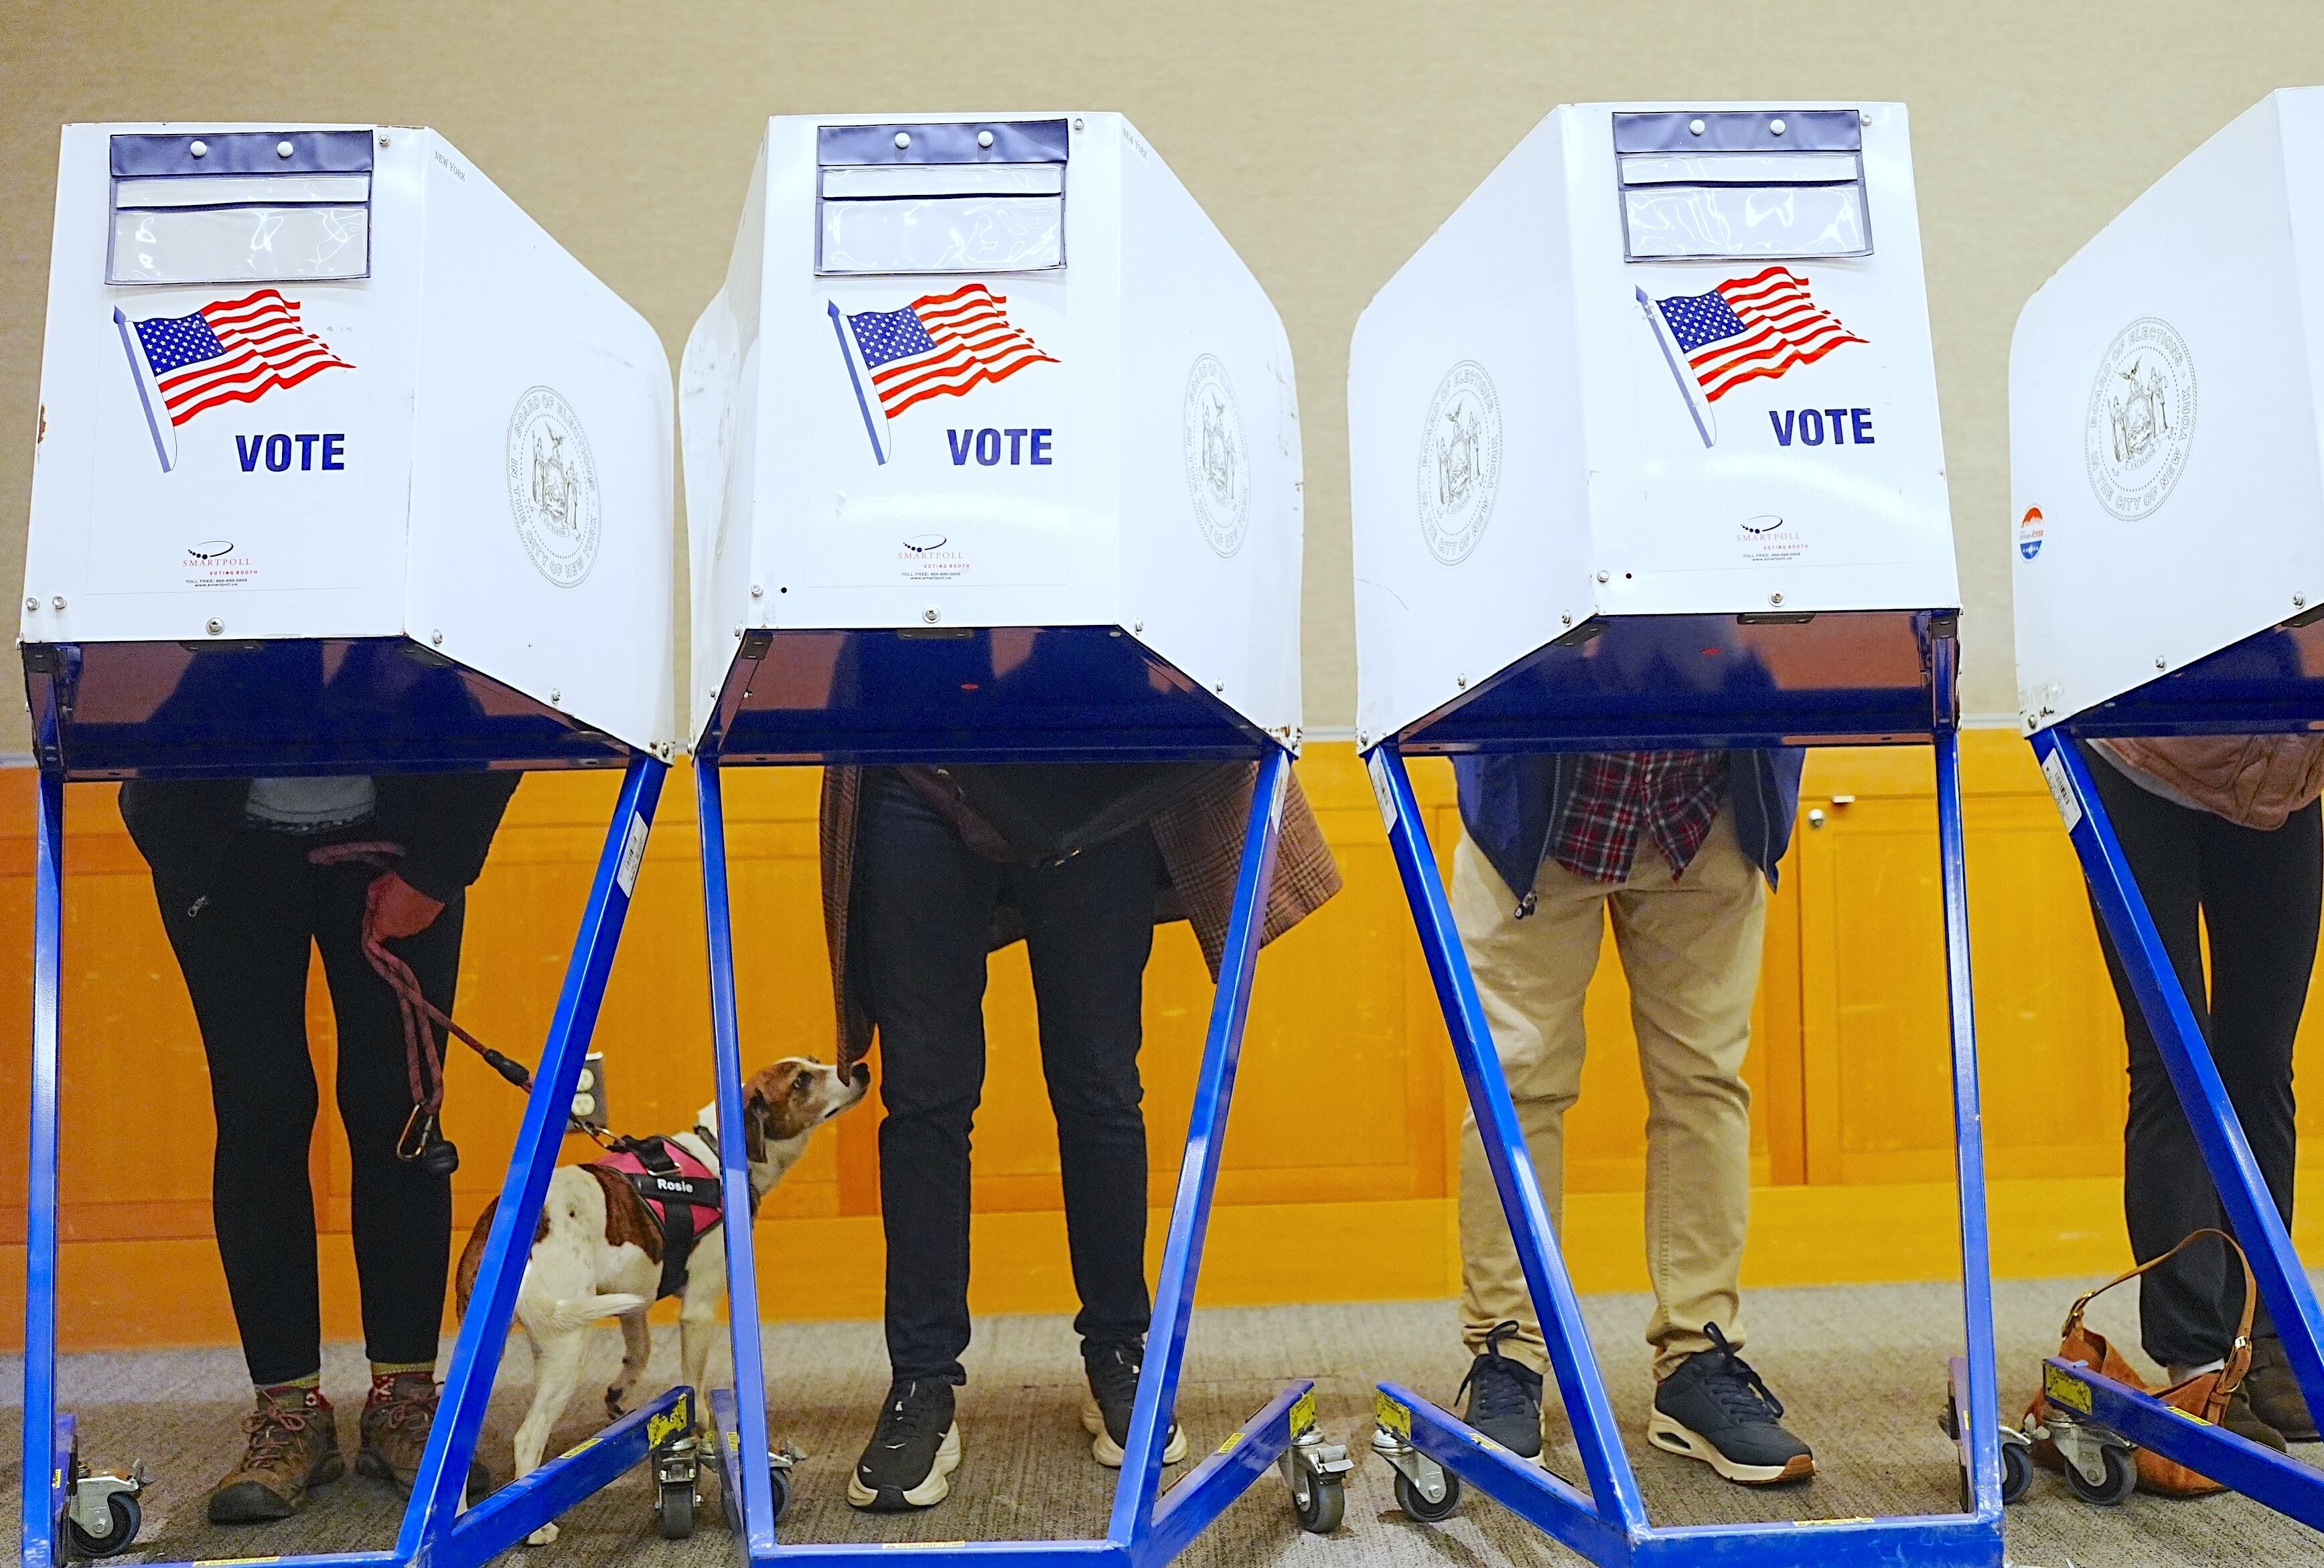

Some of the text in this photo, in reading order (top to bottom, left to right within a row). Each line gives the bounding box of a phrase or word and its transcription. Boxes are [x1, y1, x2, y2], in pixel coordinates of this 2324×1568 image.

[435, 151, 465, 182] NEW YORK
[2090, 327, 2183, 427] BOARD OF ELECTIONS
[1422, 402, 1440, 467] BOARD
[1454, 370, 1494, 414] ELECTIONS
[1770, 409, 1875, 446] VOTE
[236, 434, 344, 472] VOTE
[514, 395, 595, 492] BOARD OF ELECTIONS
[948, 429, 1051, 466] VOTE
[2090, 386, 2191, 511] IN THE CITY OF NEW YORK
[1438, 539, 1457, 555] CITY
[1459, 532, 1470, 552] OF
[1472, 496, 1488, 537] NEW
[1487, 434, 1498, 488] YORK
[511, 458, 597, 578] IN THE CITY OF NEW YORK
[1737, 532, 1801, 541] SMARTPOLL
[183, 559, 251, 567] SMARTPOLL
[657, 1178, 693, 1193] Rosie
